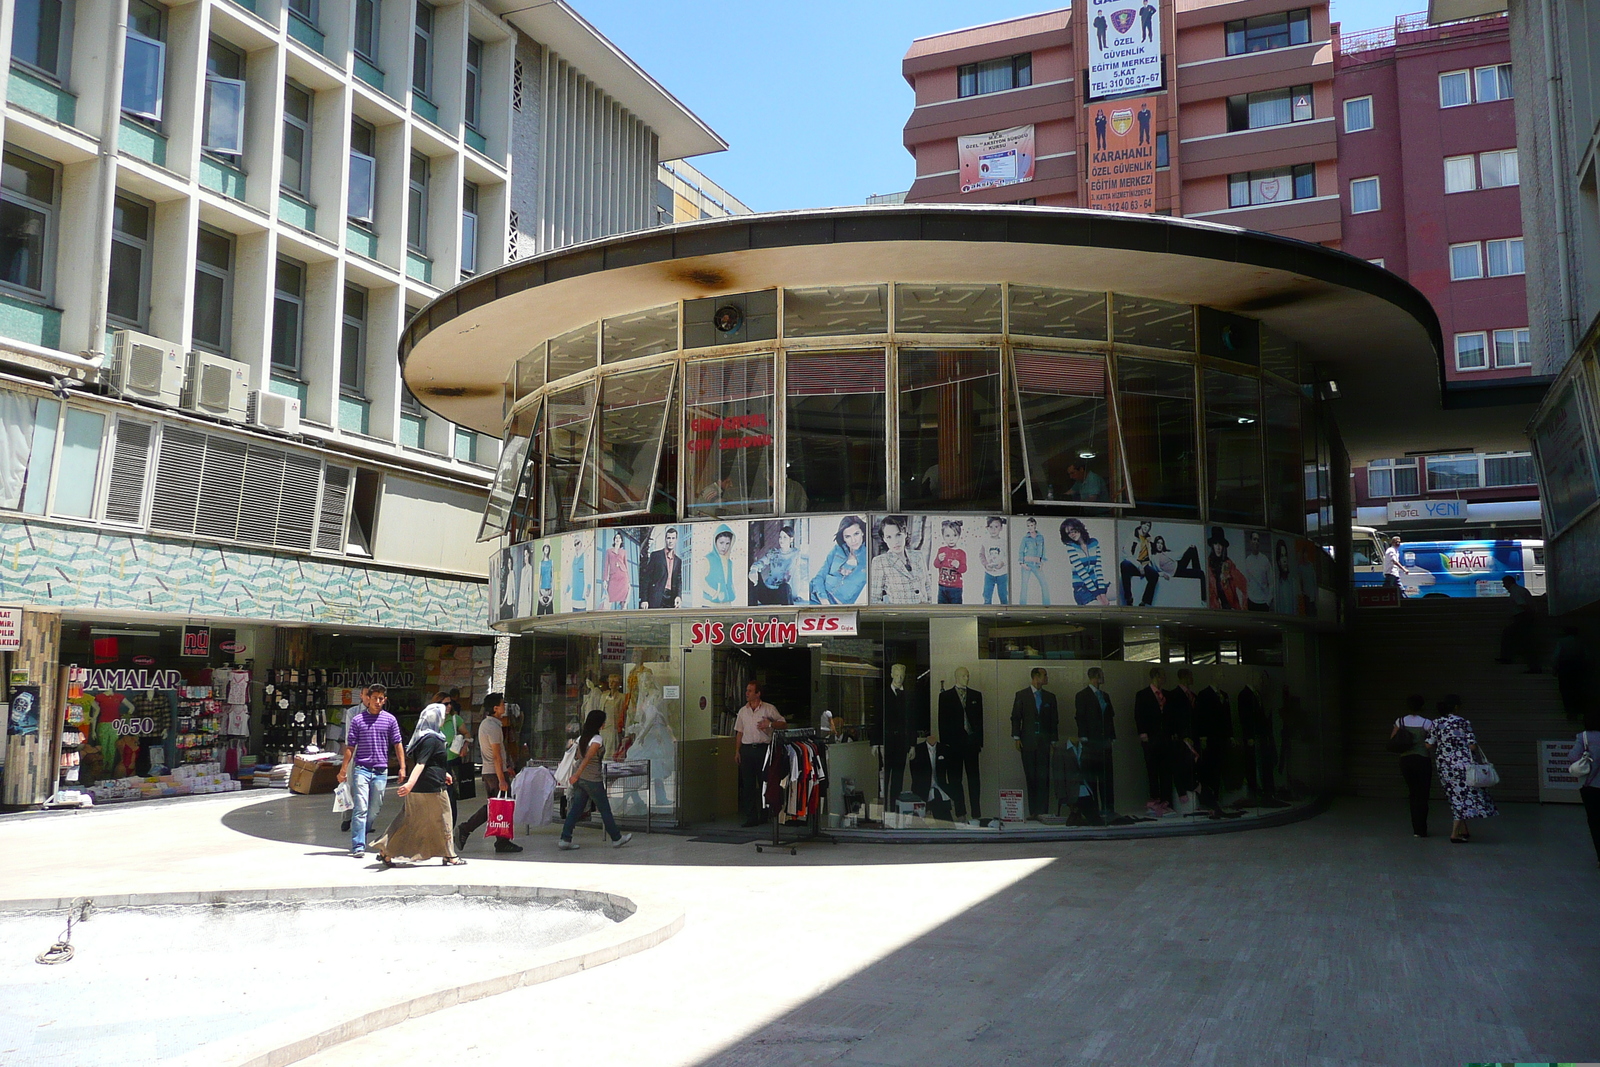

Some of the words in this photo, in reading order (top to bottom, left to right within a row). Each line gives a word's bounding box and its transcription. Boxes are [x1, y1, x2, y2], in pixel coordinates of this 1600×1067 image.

[1114, 37, 1135, 46] ÖZEL
[1103, 47, 1145, 59] GÜVENLİK
[1092, 61, 1119, 73] EĞİTİM
[1121, 54, 1158, 68] MERKEZİ
[1113, 68, 1136, 78] 5.KAT
[1092, 82, 1108, 91] TEL:
[1109, 78, 1123, 88] 310
[1125, 77, 1135, 86] 06
[1136, 73, 1159, 83] 37-67
[1093, 146, 1152, 163] KARAHANLI
[1092, 166, 1111, 177] ÖZEL
[1113, 160, 1152, 175] GÜVENLİK
[1091, 177, 1117, 191] EĞİTİM
[1120, 172, 1153, 188] MERKEZİ
[1108, 201, 1119, 211] 312
[1121, 200, 1130, 210] 40
[1130, 200, 1139, 210] 63
[1143, 198, 1152, 208] 64
[719, 434, 772, 450] SALONU
[1394, 510, 1420, 518] HOTEL
[1425, 502, 1459, 517] YENİ
[1449, 555, 1488, 568] HAYAT
[185, 630, 209, 648] nü
[690, 620, 725, 645] SİS
[730, 617, 798, 645] GİYİM
[332, 668, 415, 689] PİJAMALAR
[111, 716, 154, 735] %50
